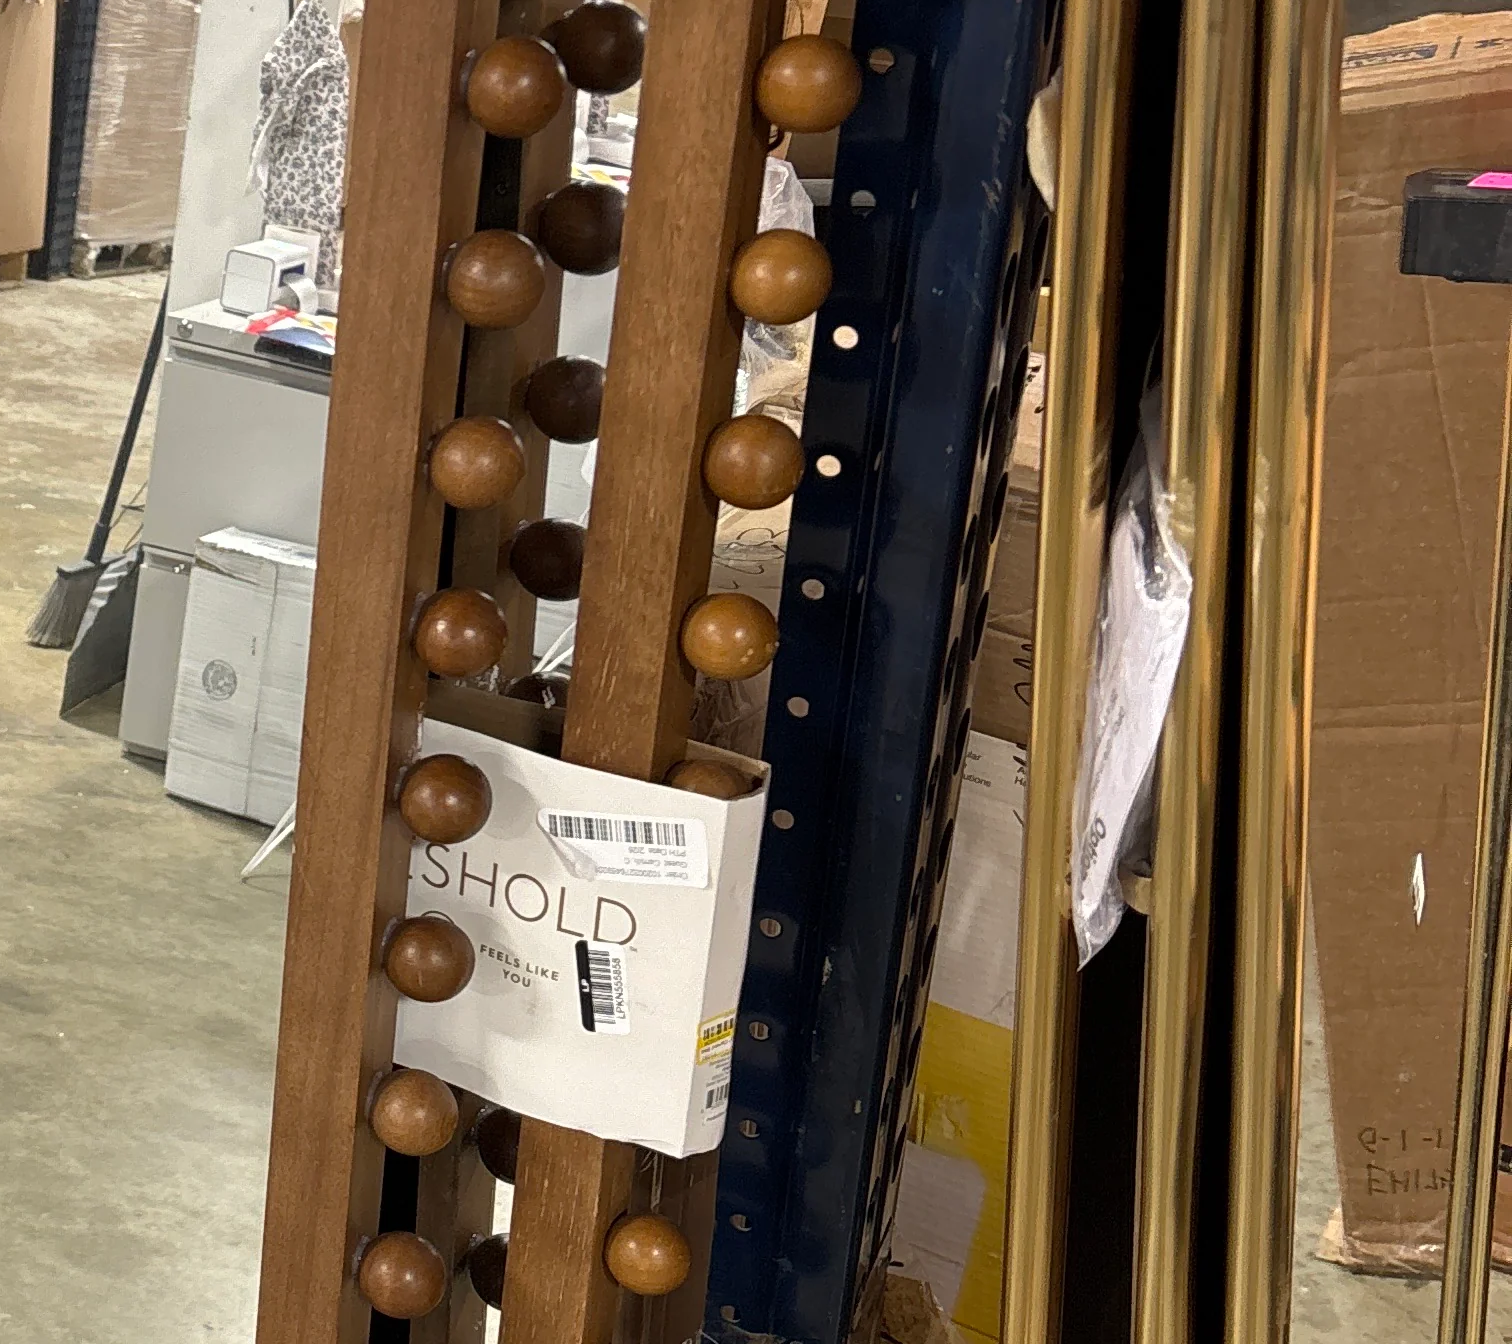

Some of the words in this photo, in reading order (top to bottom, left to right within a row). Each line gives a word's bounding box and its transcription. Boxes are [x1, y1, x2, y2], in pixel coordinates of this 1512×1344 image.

[407, 842, 637, 946] SHOLD
[479, 943, 521, 969] FEELS
[525, 961, 560, 982] LIKE
[502, 968, 532, 988] YOU
